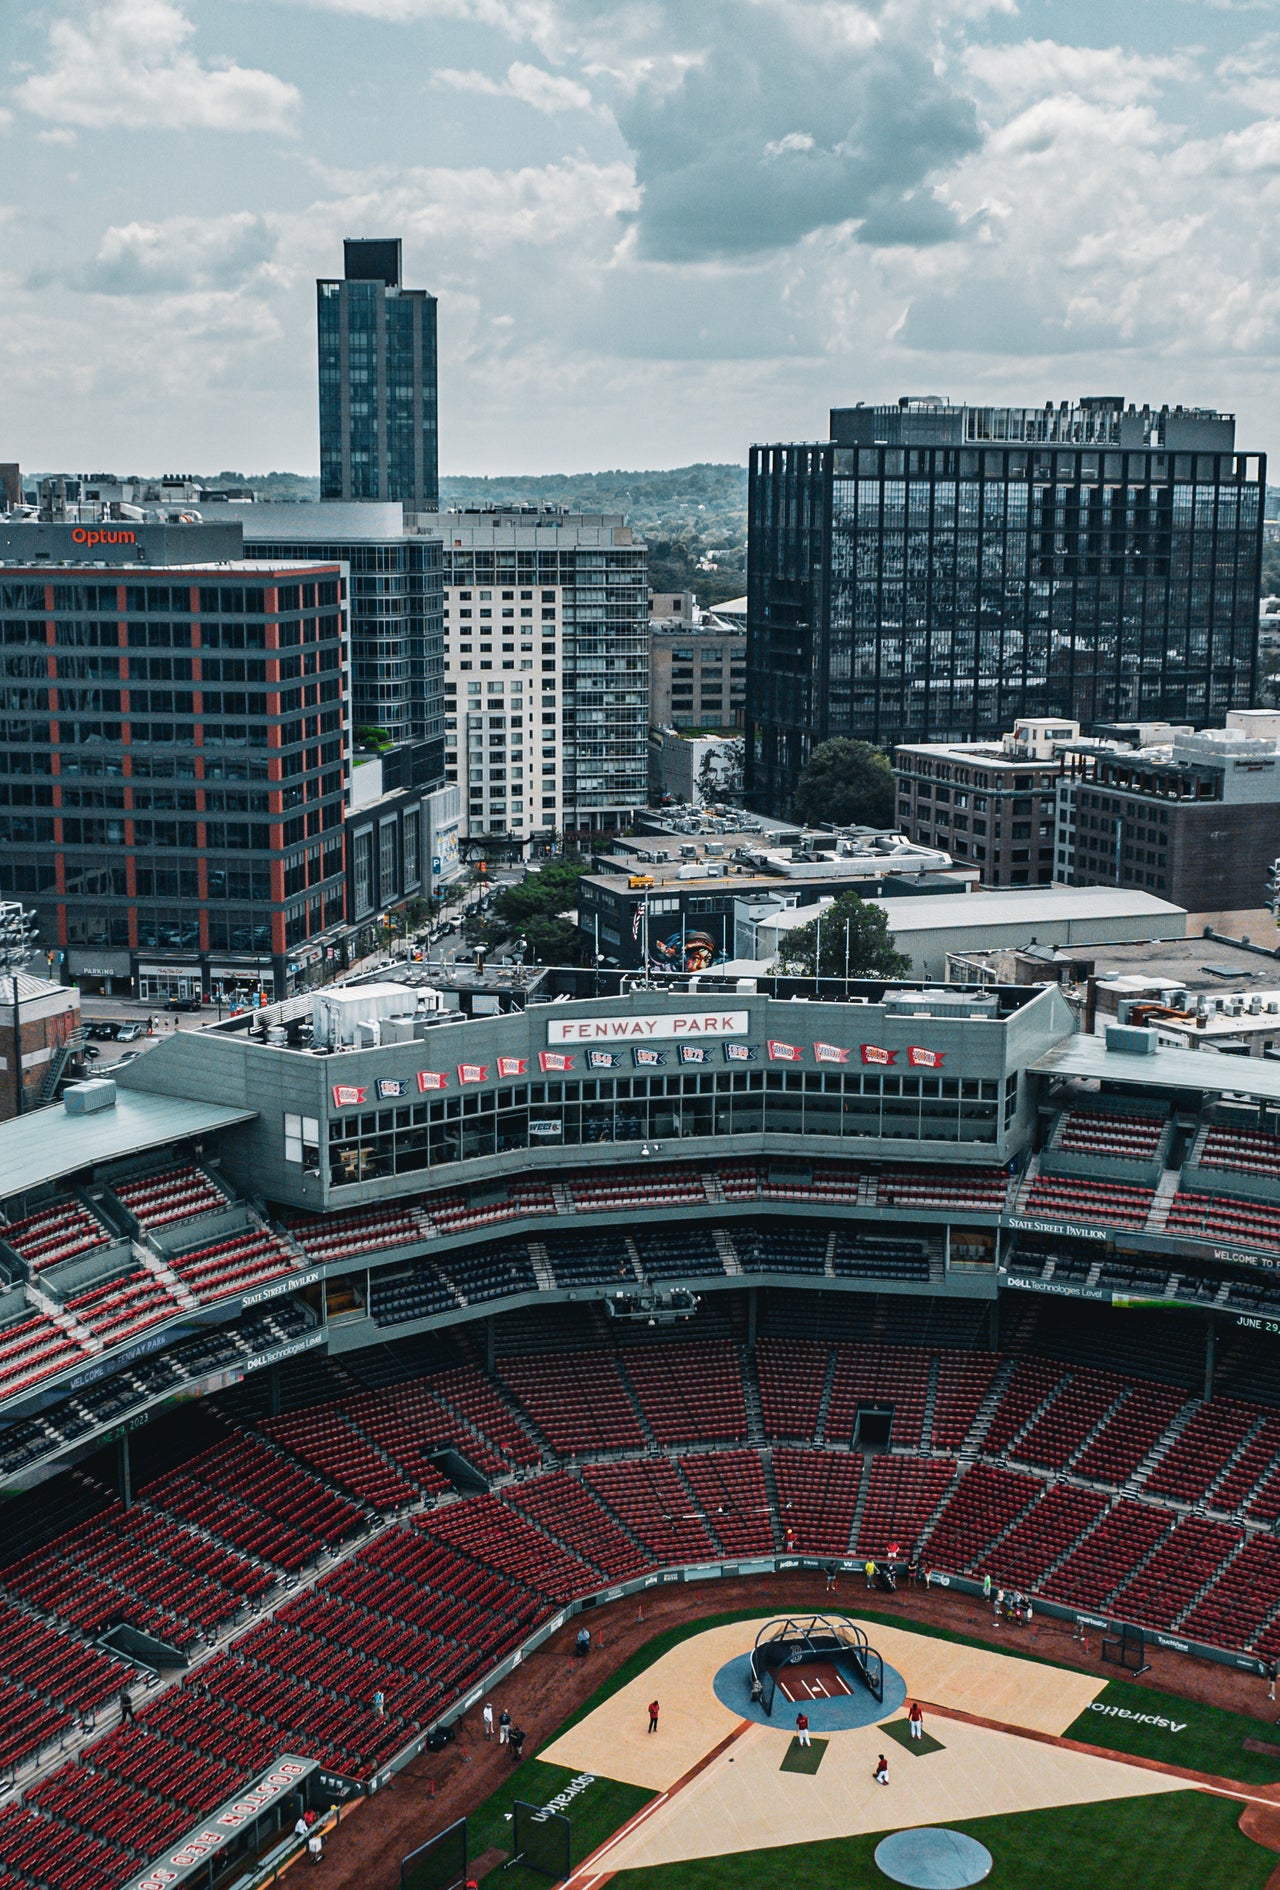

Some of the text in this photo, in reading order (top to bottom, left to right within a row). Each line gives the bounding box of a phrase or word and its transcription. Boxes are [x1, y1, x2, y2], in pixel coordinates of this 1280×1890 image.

[71, 527, 136, 548] Optum
[83, 967, 114, 975] PARKING
[562, 1016, 735, 1038] FENWAY PARK
[1009, 1219, 1107, 1240] STATE STREET PAVILION
[1214, 1249, 1258, 1266] WELCOME
[1261, 1258, 1274, 1268] TO
[242, 1273, 319, 1307] STATE STREET PAVILION
[1032, 1281, 1081, 1297] Technologies
[1082, 1288, 1103, 1299] Level
[1237, 1317, 1262, 1330] JUNE
[267, 1340, 305, 1363] Technologies
[305, 1334, 322, 1348] Level
[70, 1368, 104, 1391] WELCOME
[144, 1336, 166, 1351] PARK
[218, 1762, 306, 1827] BOSTON
[530, 1772, 595, 1822] spiration
[170, 1830, 225, 1866] RED
